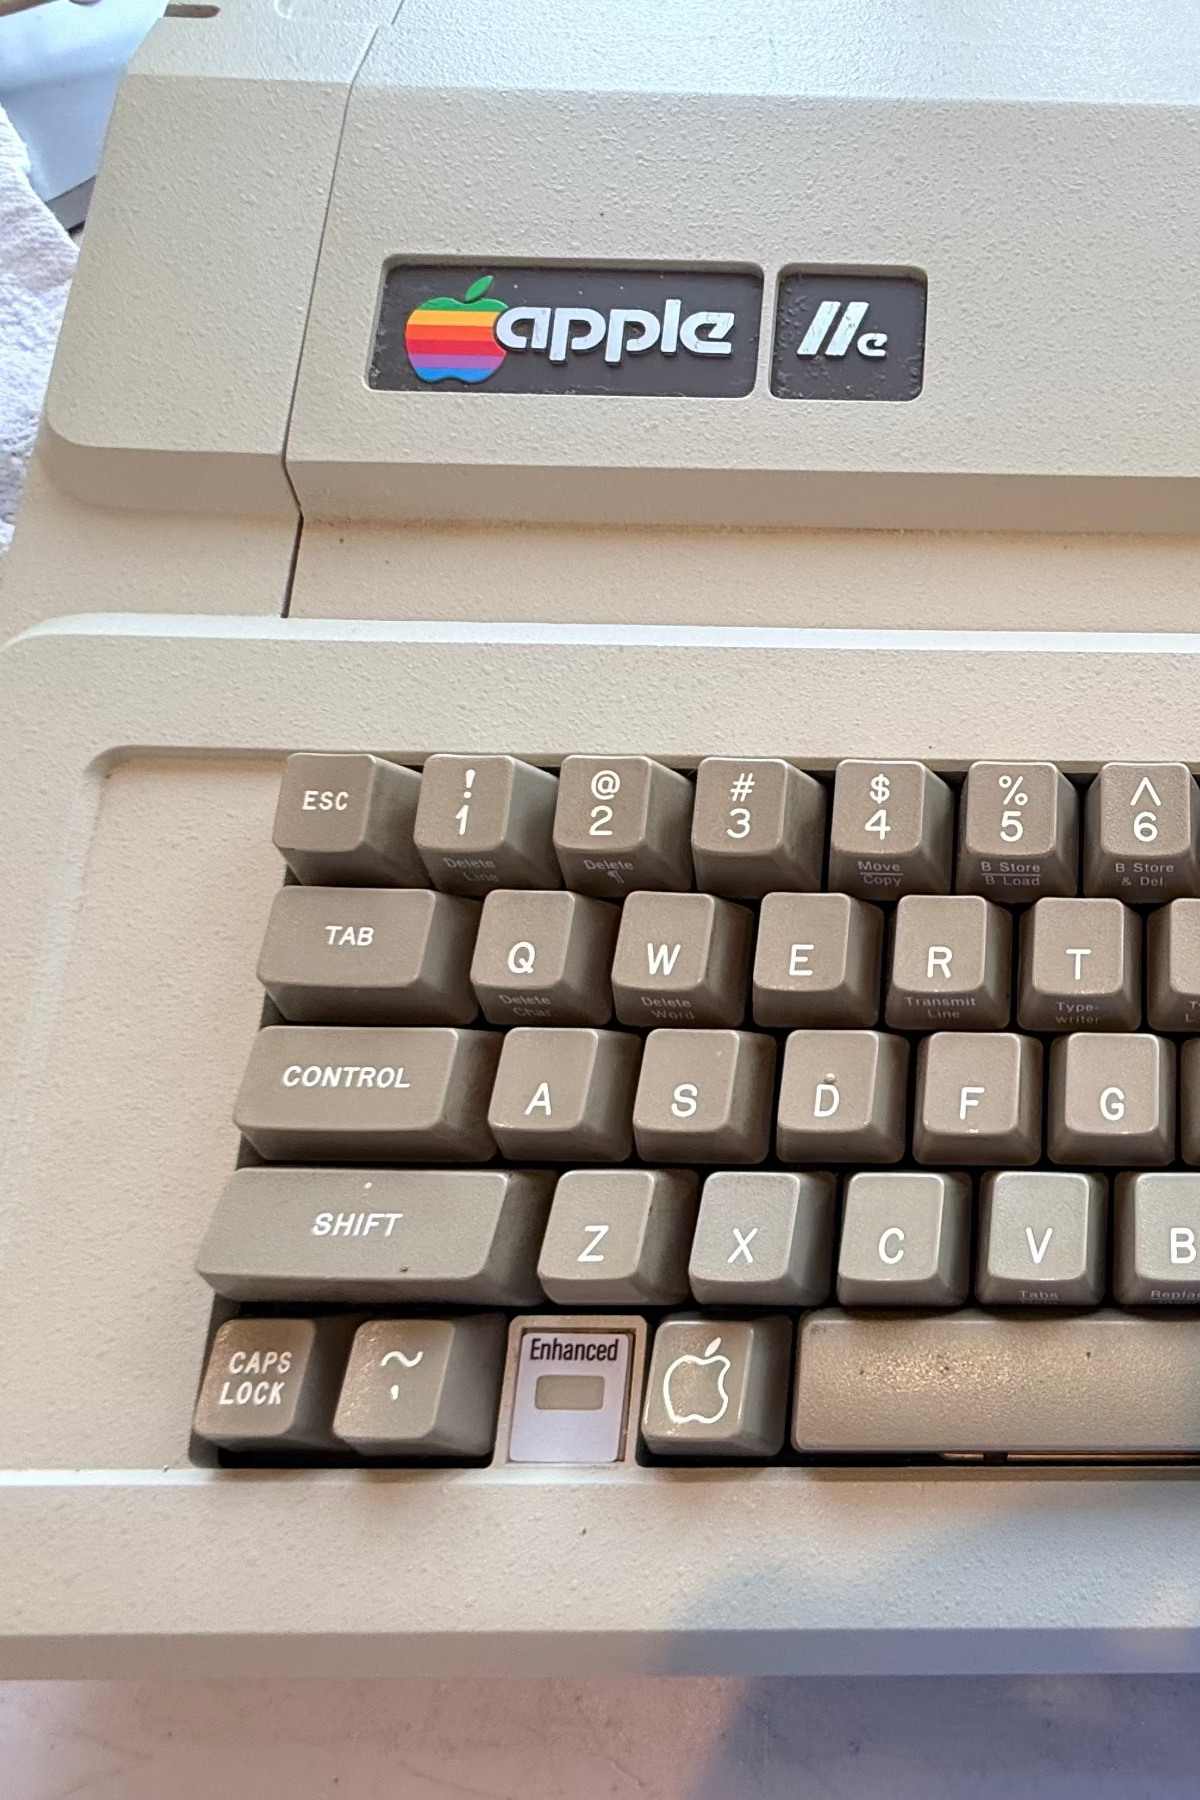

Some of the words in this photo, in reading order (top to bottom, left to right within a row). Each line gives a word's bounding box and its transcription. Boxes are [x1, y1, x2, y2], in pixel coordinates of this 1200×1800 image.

[496, 298, 735, 364] apple
[463, 769, 476, 799] !
[590, 769, 621, 801] @
[729, 772, 756, 802] #
[869, 773, 890, 804] $
[998, 775, 1029, 806] %
[302, 790, 349, 811] ESC
[455, 804, 469, 836] 1
[589, 805, 613, 836] 2
[726, 808, 751, 839] 3
[864, 809, 891, 841] 4
[1000, 810, 1024, 842] 5
[1133, 811, 1158, 842] 6
[443, 857, 497, 870] Delete
[584, 859, 635, 871] Delete
[857, 861, 901, 873] Move
[981, 861, 992, 873] B
[1000, 861, 1042, 874] Store
[1115, 862, 1125, 874] B
[1133, 862, 1176, 874] Store
[863, 874, 902, 887] Copy
[984, 874, 996, 887] B
[1003, 874, 1041, 887] Load
[1121, 876, 1132, 887] &
[325, 925, 375, 946] TAB
[507, 941, 536, 974] Q
[647, 942, 681, 976] W
[788, 944, 815, 976] E
[927, 946, 953, 979] R
[1065, 948, 1092, 981] T
[499, 994, 551, 1006] Delete
[641, 996, 691, 1008] Delete
[652, 1009, 695, 1020] Word
[904, 996, 976, 1008] Transmit
[927, 1009, 960, 1019] Line
[282, 1065, 411, 1089] CONTROL
[524, 1082, 552, 1116] A
[671, 1083, 698, 1118] S
[813, 1083, 840, 1118] D
[959, 1086, 985, 1120] F
[1099, 1087, 1125, 1121] G
[312, 1212, 404, 1237] SHIFT
[577, 1225, 609, 1262] Z
[727, 1227, 759, 1264] X
[878, 1227, 905, 1265] C
[1025, 1227, 1053, 1264] V
[1170, 1227, 1197, 1264] B
[1019, 1290, 1059, 1300] Tabs
[228, 1351, 292, 1375] CAPS
[529, 1338, 620, 1363] Enhanced
[218, 1381, 285, 1405] LOCK
